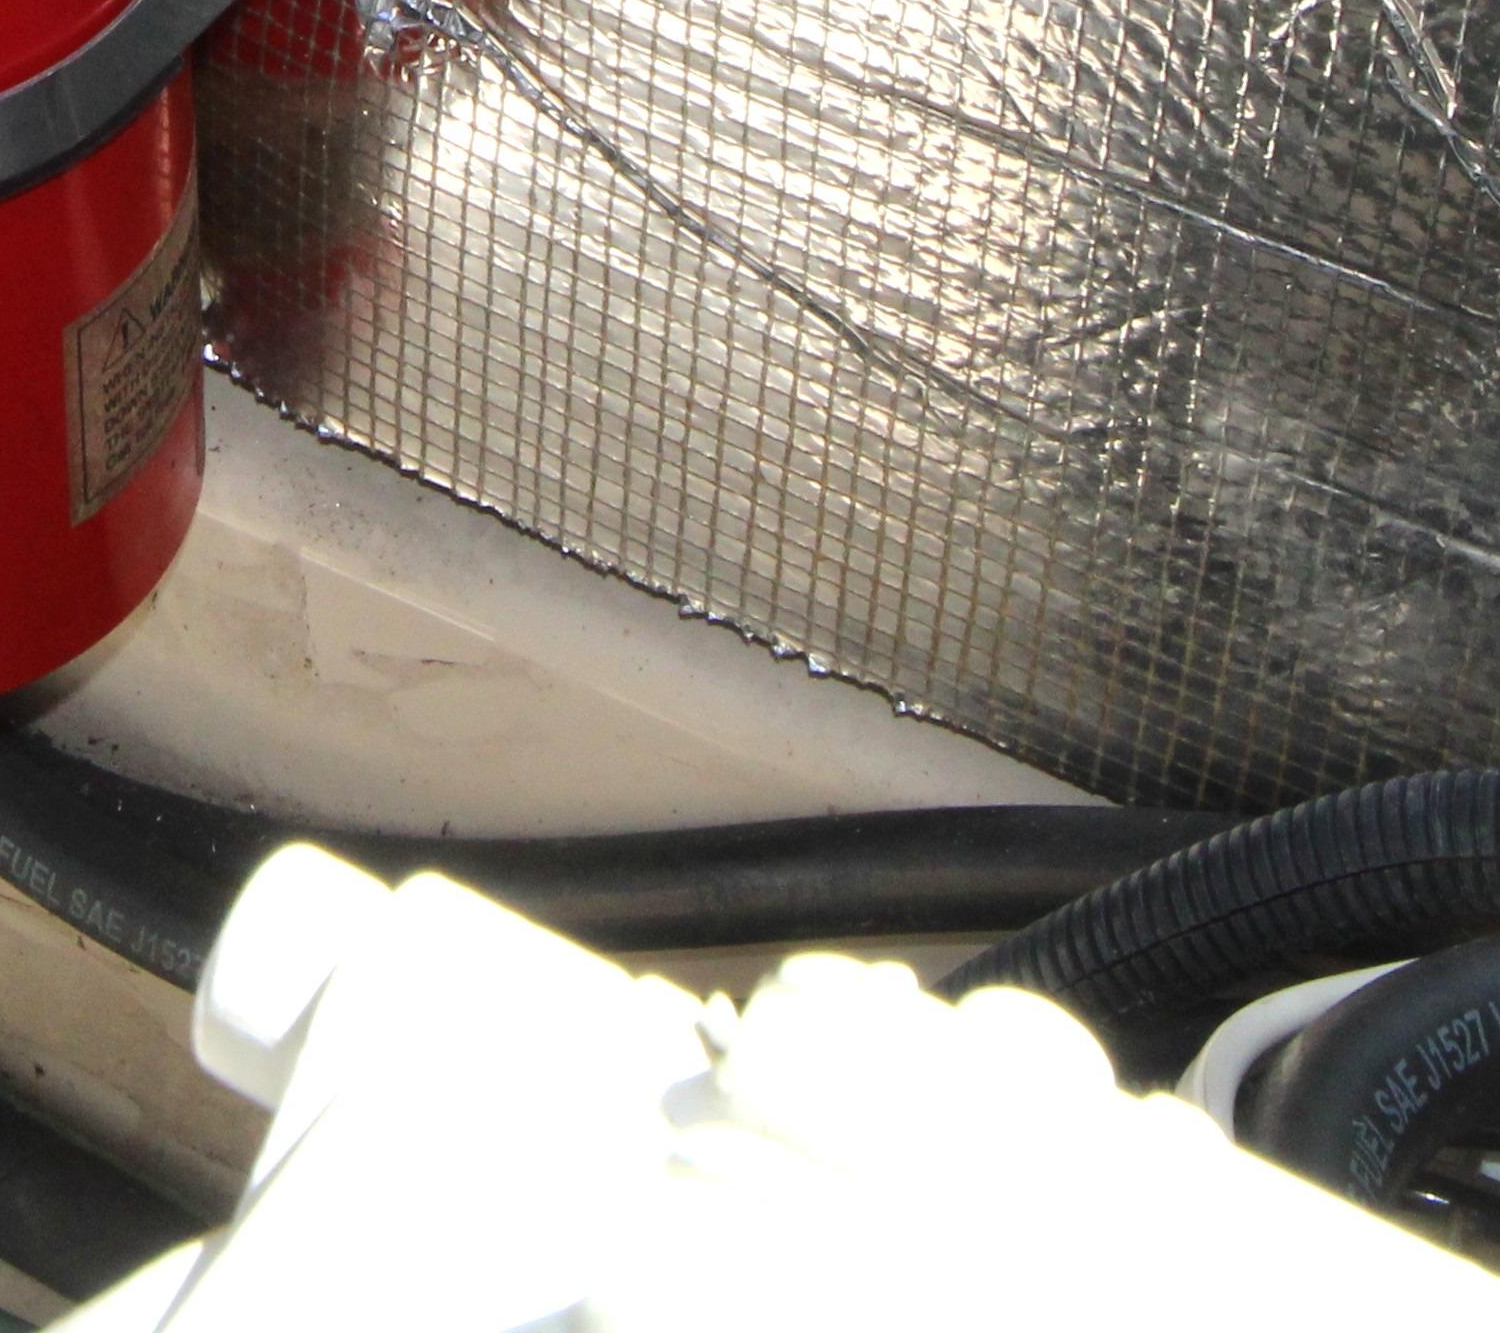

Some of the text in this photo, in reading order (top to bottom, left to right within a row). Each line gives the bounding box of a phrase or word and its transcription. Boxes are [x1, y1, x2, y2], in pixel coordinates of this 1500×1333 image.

[70, 887, 127, 944] SAE
[131, 925, 194, 973] J152
[1374, 1057, 1429, 1132] SAE
[1415, 1008, 1489, 1093] J1527
